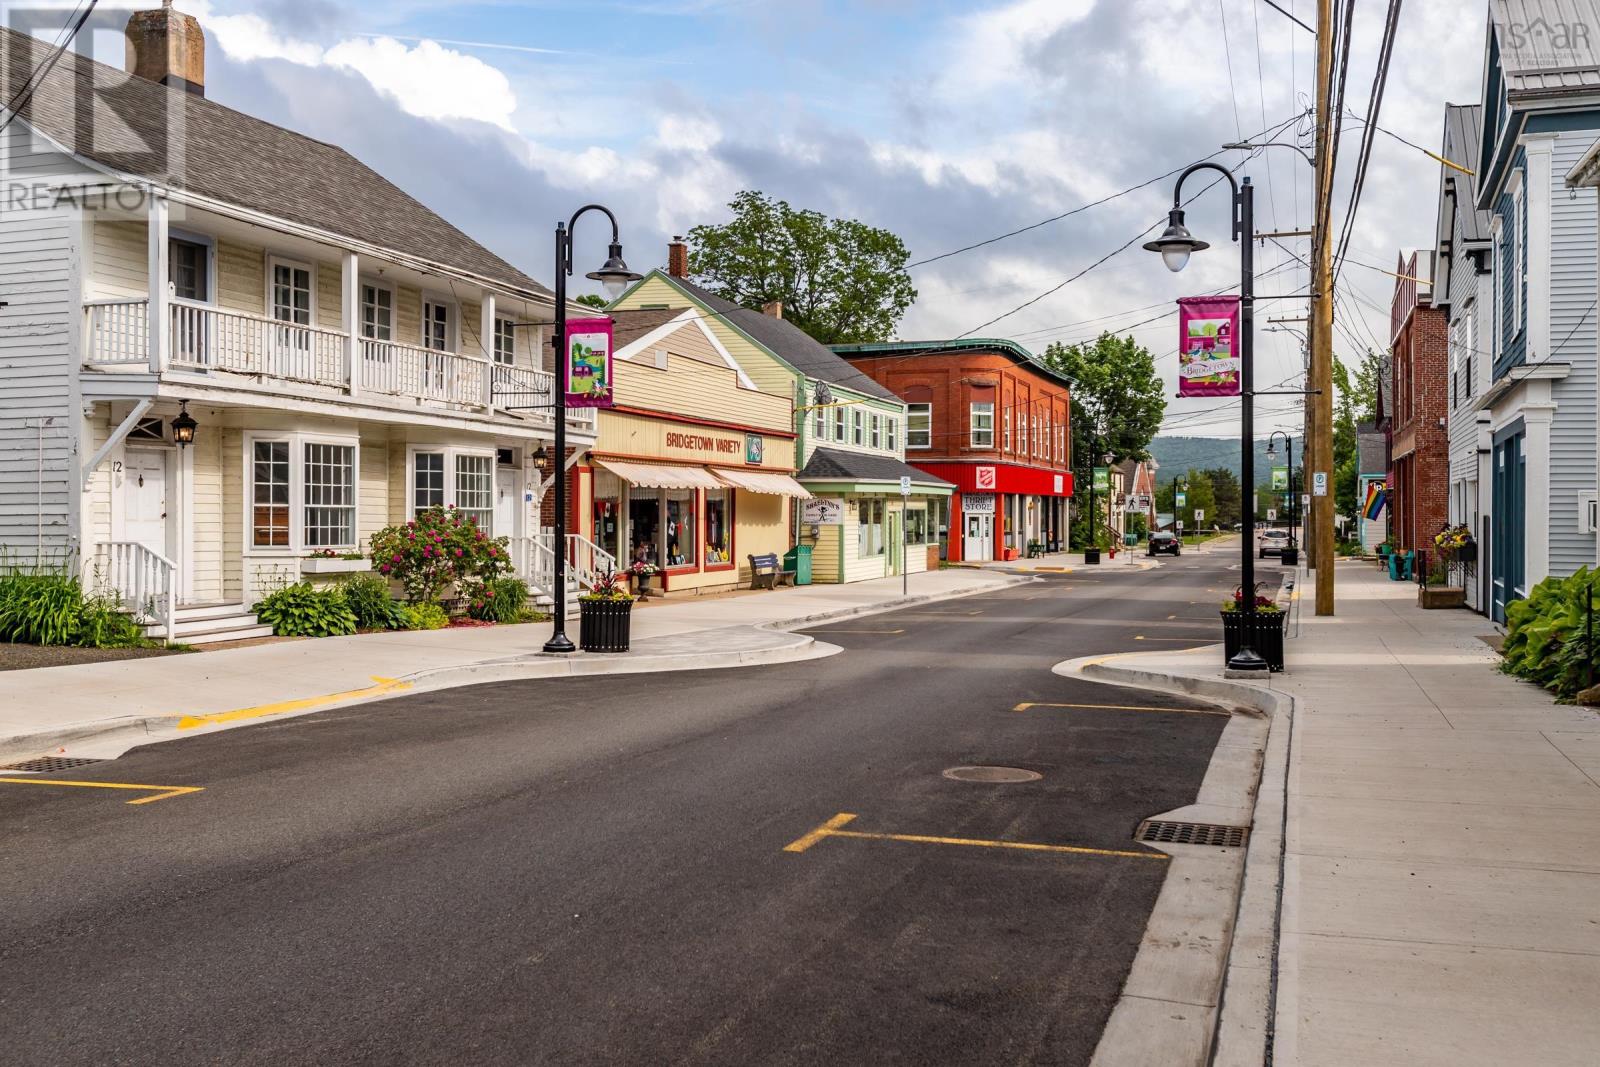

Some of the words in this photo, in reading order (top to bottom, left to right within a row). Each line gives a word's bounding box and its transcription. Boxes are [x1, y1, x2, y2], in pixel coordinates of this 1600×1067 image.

[666, 432, 713, 452] BRIDGETOWN
[716, 438, 741, 454] VARIETY
[113, 461, 122, 472] 12
[965, 503, 993, 511] STORE
